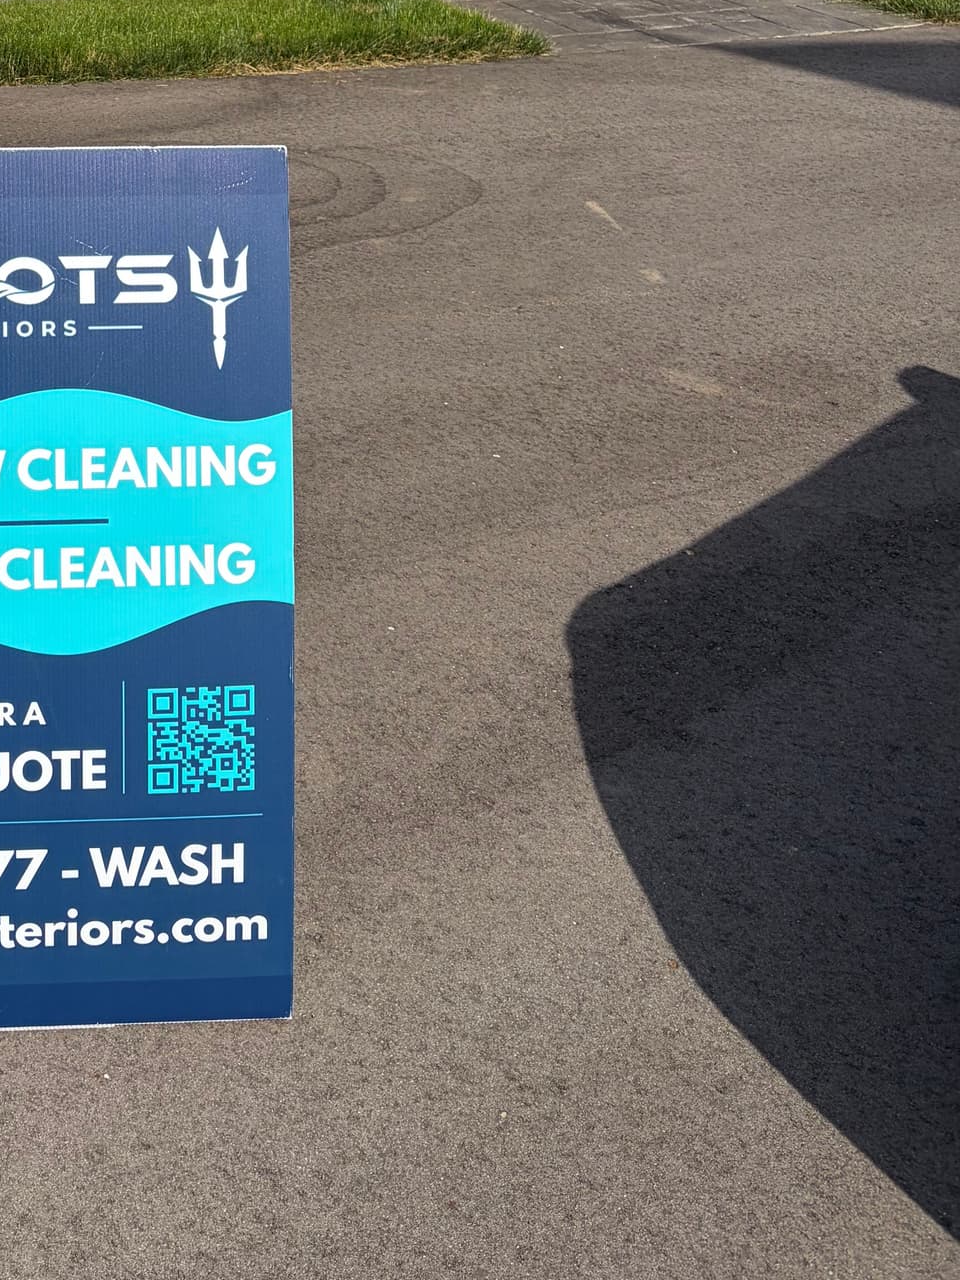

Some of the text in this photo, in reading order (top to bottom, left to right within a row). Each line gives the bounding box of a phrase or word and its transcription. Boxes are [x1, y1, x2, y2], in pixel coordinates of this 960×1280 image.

[17, 443, 276, 491] CLEANING
[22, 701, 47, 726] A
[88, 842, 245, 888] WASH
